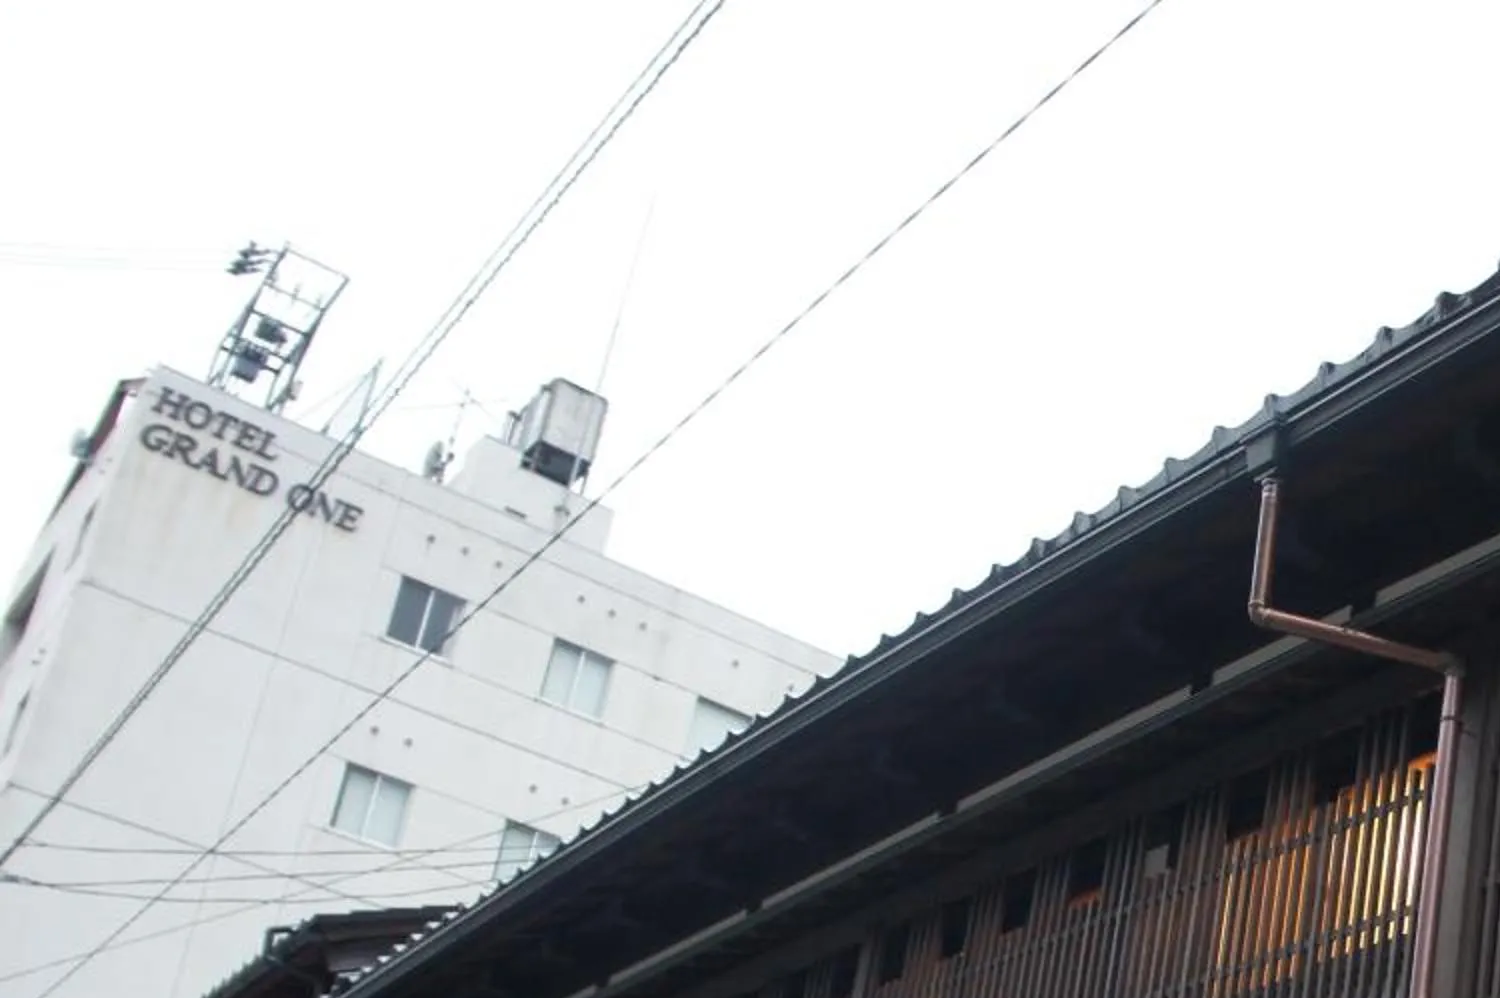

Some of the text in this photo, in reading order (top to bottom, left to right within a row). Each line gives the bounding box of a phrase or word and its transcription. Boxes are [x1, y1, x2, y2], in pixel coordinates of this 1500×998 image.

[151, 386, 279, 461] HOTEL
[140, 423, 365, 532] GRAND ONE
